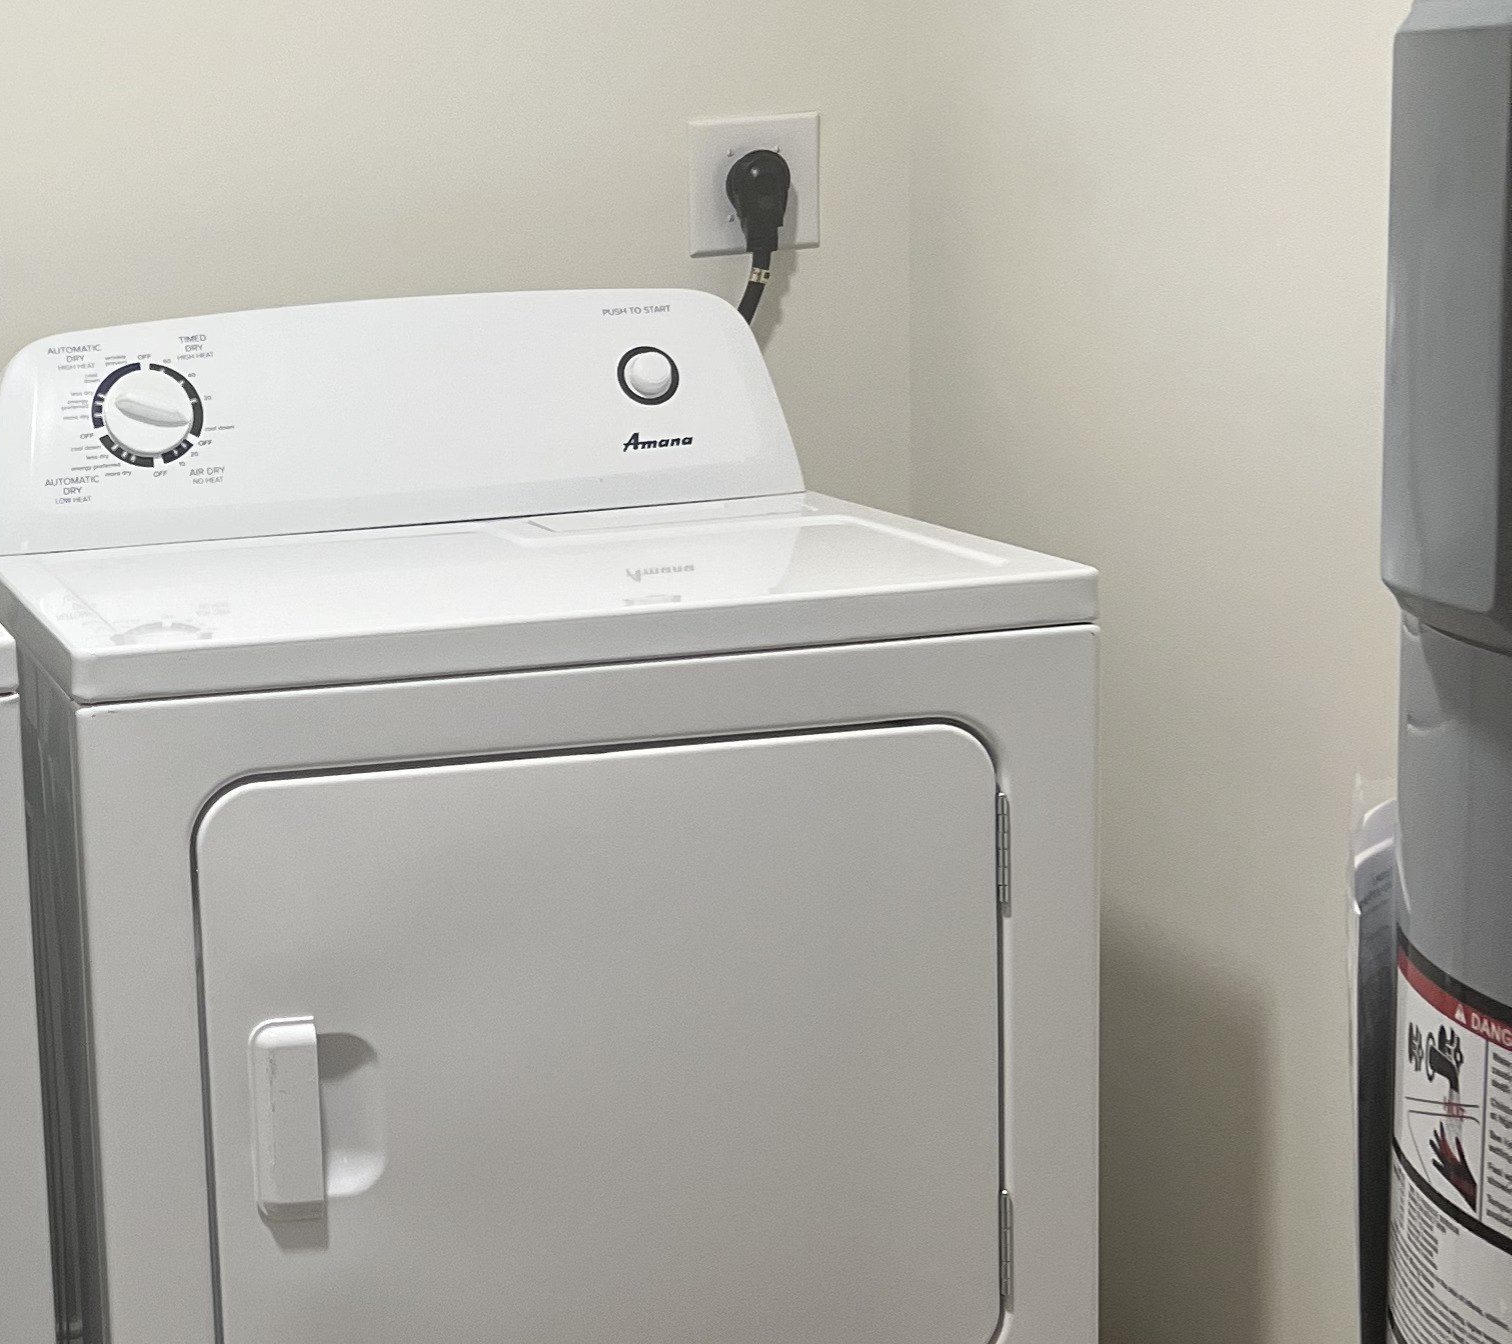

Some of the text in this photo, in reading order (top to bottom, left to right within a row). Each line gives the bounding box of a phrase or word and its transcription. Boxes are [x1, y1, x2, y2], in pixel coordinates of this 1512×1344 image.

[602, 305, 671, 316] PUSH TO START
[179, 334, 207, 343] TIMED
[47, 344, 102, 355] AUTOMATIC
[185, 344, 203, 353] DRY
[66, 355, 85, 363] DRY
[198, 439, 212, 447] OFF
[623, 432, 694, 452] Amana
[153, 470, 168, 478] OFF
[189, 466, 226, 477] AIR DRY
[44, 475, 100, 487] AUTOMATIC
[205, 476, 224, 484] HEAT
[63, 486, 83, 495] DRY
[73, 495, 92, 504] HEAT
